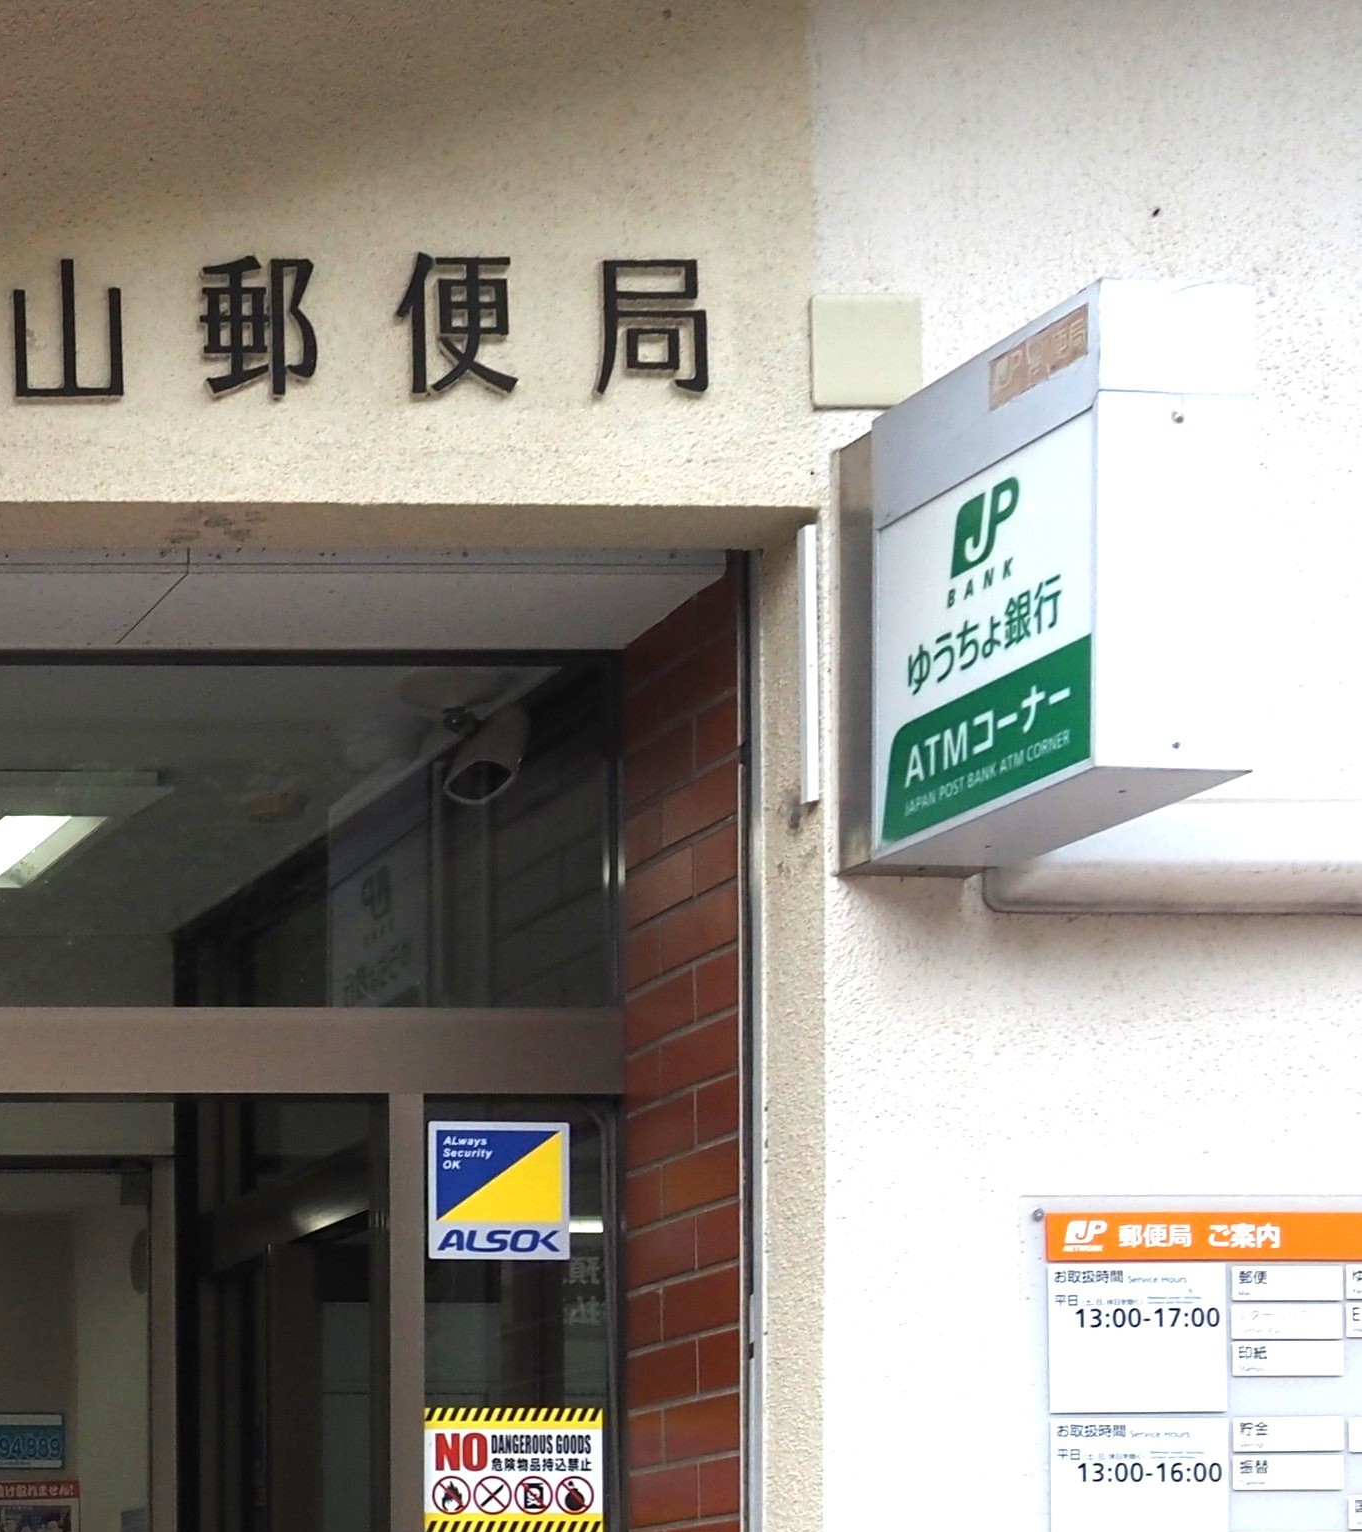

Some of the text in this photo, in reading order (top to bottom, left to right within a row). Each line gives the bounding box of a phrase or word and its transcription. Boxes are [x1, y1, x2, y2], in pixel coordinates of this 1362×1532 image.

[950, 476, 1020, 580] JP
[946, 556, 1014, 609] BANK
[906, 573, 1062, 696] ゆうちょ銀行
[904, 684, 1071, 789] ATMコーナー
[905, 728, 1071, 817] JAPAN POST BANK ATM CORNER
[443, 1136, 487, 1148] ALways
[443, 1148, 493, 1160] Security
[442, 1160, 462, 1170] OK
[437, 1229, 561, 1253] ALSOK
[1065, 1220, 1281, 1249] JP 郵便局 ご案内
[1075, 1307, 1221, 1329] 13:00-17:00
[435, 1433, 592, 1471] NO DANGEROUS GOODS
[491, 1456, 593, 1473] 危険物品持込禁止
[1077, 1462, 1223, 1483] 13:00-16:00
